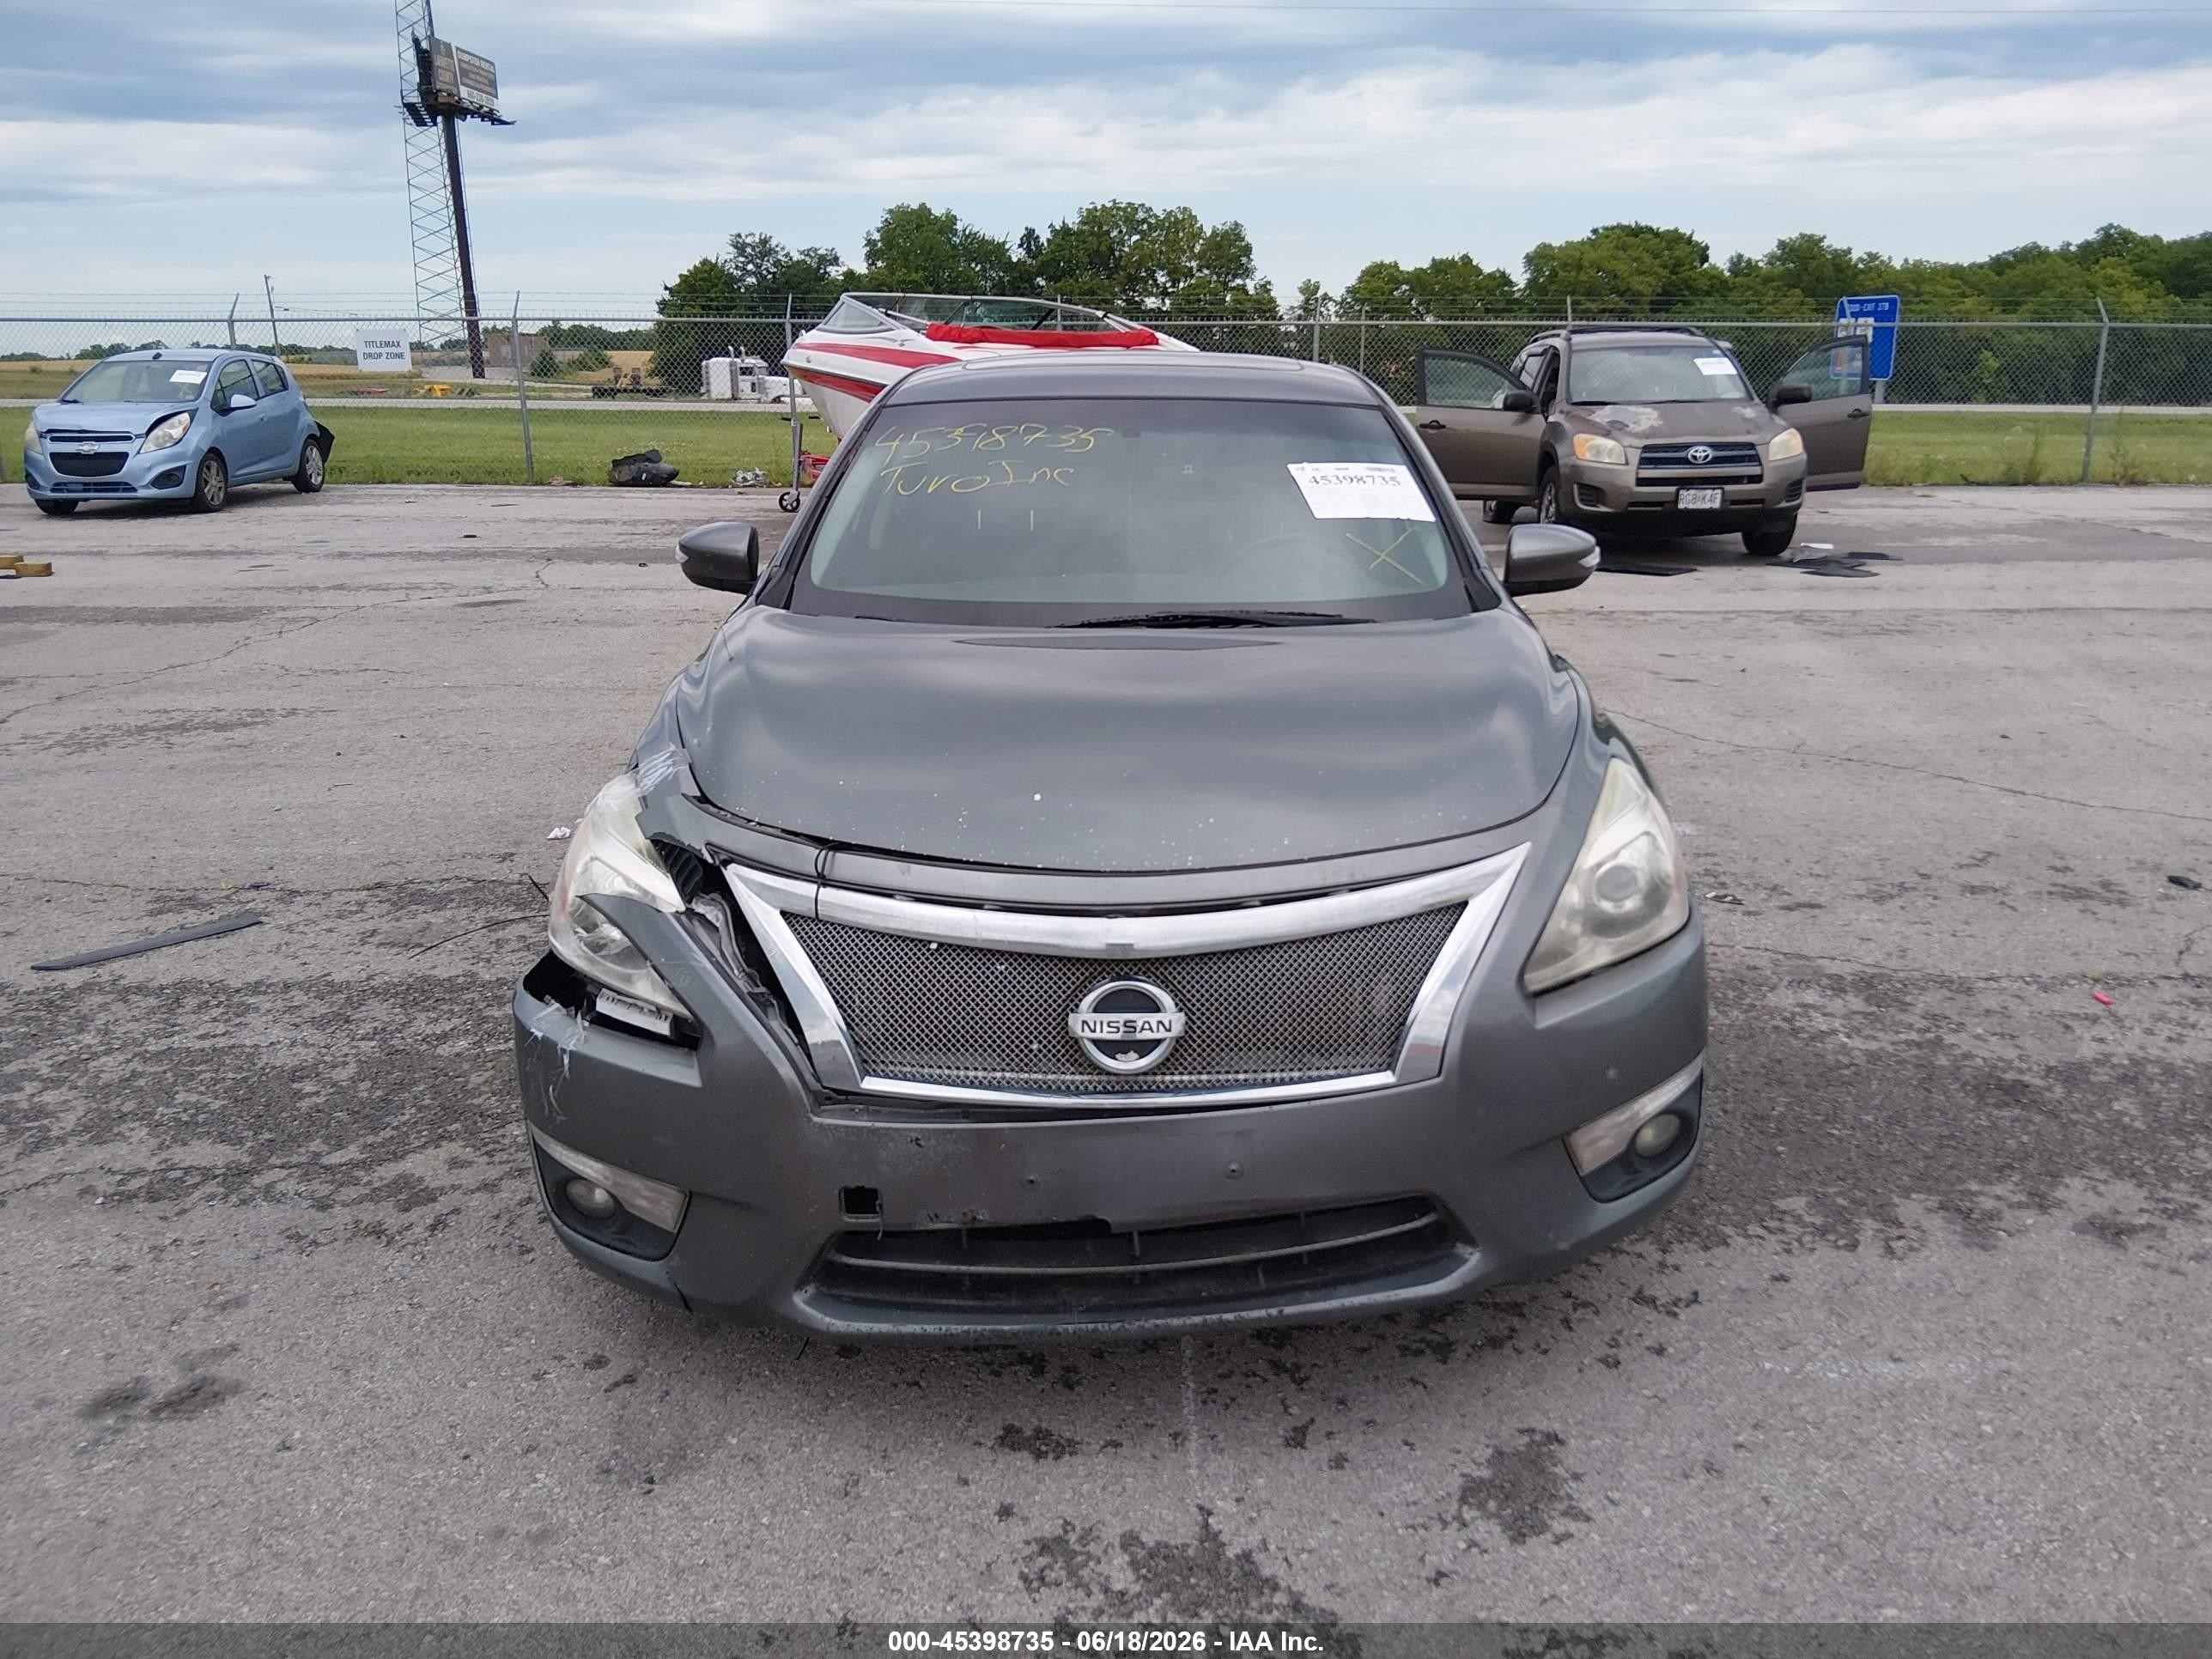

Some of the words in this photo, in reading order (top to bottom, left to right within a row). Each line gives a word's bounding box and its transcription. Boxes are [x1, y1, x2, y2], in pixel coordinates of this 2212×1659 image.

[363, 340, 401, 349] TITLEMAX
[362, 351, 383, 360] DROP
[385, 351, 405, 360] ZONE
[1308, 474, 1401, 487] 45398735
[1080, 1019, 1172, 1034] NISSAN
